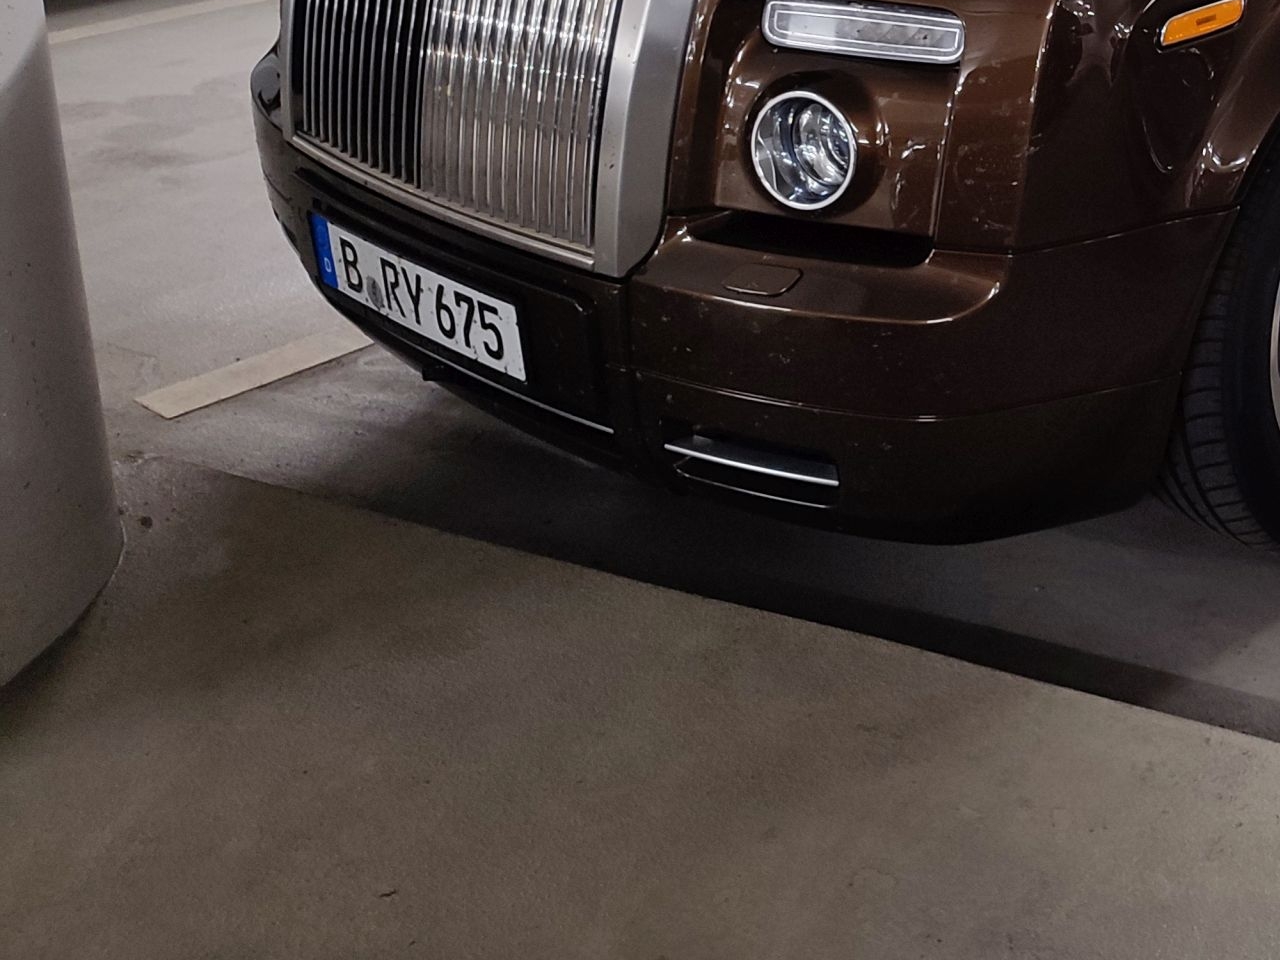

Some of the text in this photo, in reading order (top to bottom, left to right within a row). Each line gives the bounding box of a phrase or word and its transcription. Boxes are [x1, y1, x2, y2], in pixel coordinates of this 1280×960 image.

[338, 236, 504, 360] B RY 675
